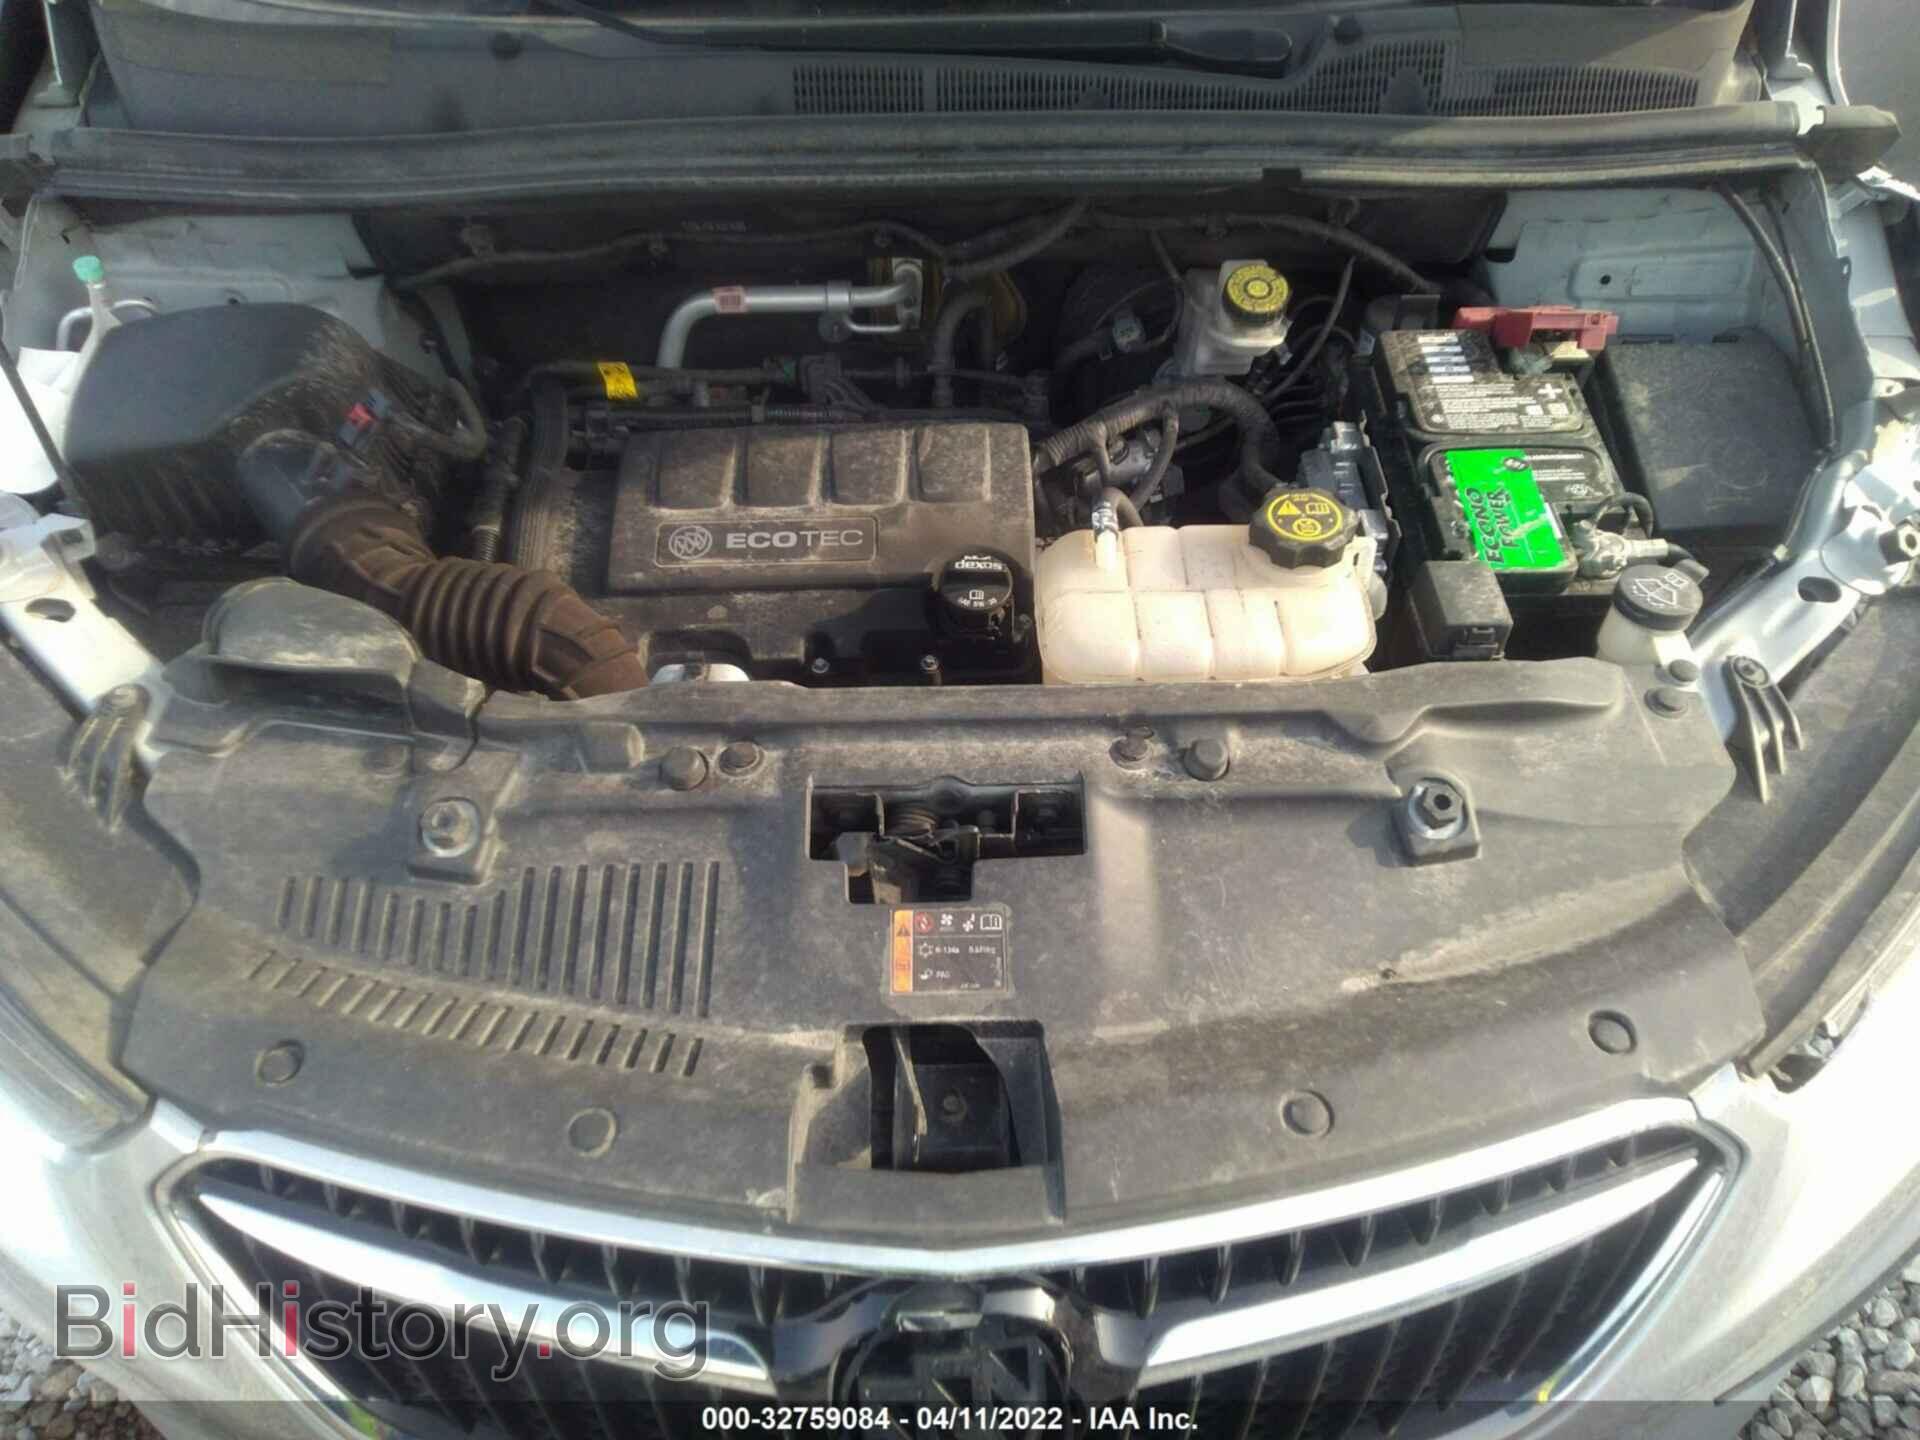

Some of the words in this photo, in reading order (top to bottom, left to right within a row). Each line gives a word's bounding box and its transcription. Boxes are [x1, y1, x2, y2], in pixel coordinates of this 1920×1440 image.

[1465, 487, 1505, 563] ECONO
[1487, 486, 1520, 547] POWER
[725, 529, 864, 549] ECOTEC
[954, 559, 1002, 570] dexos
